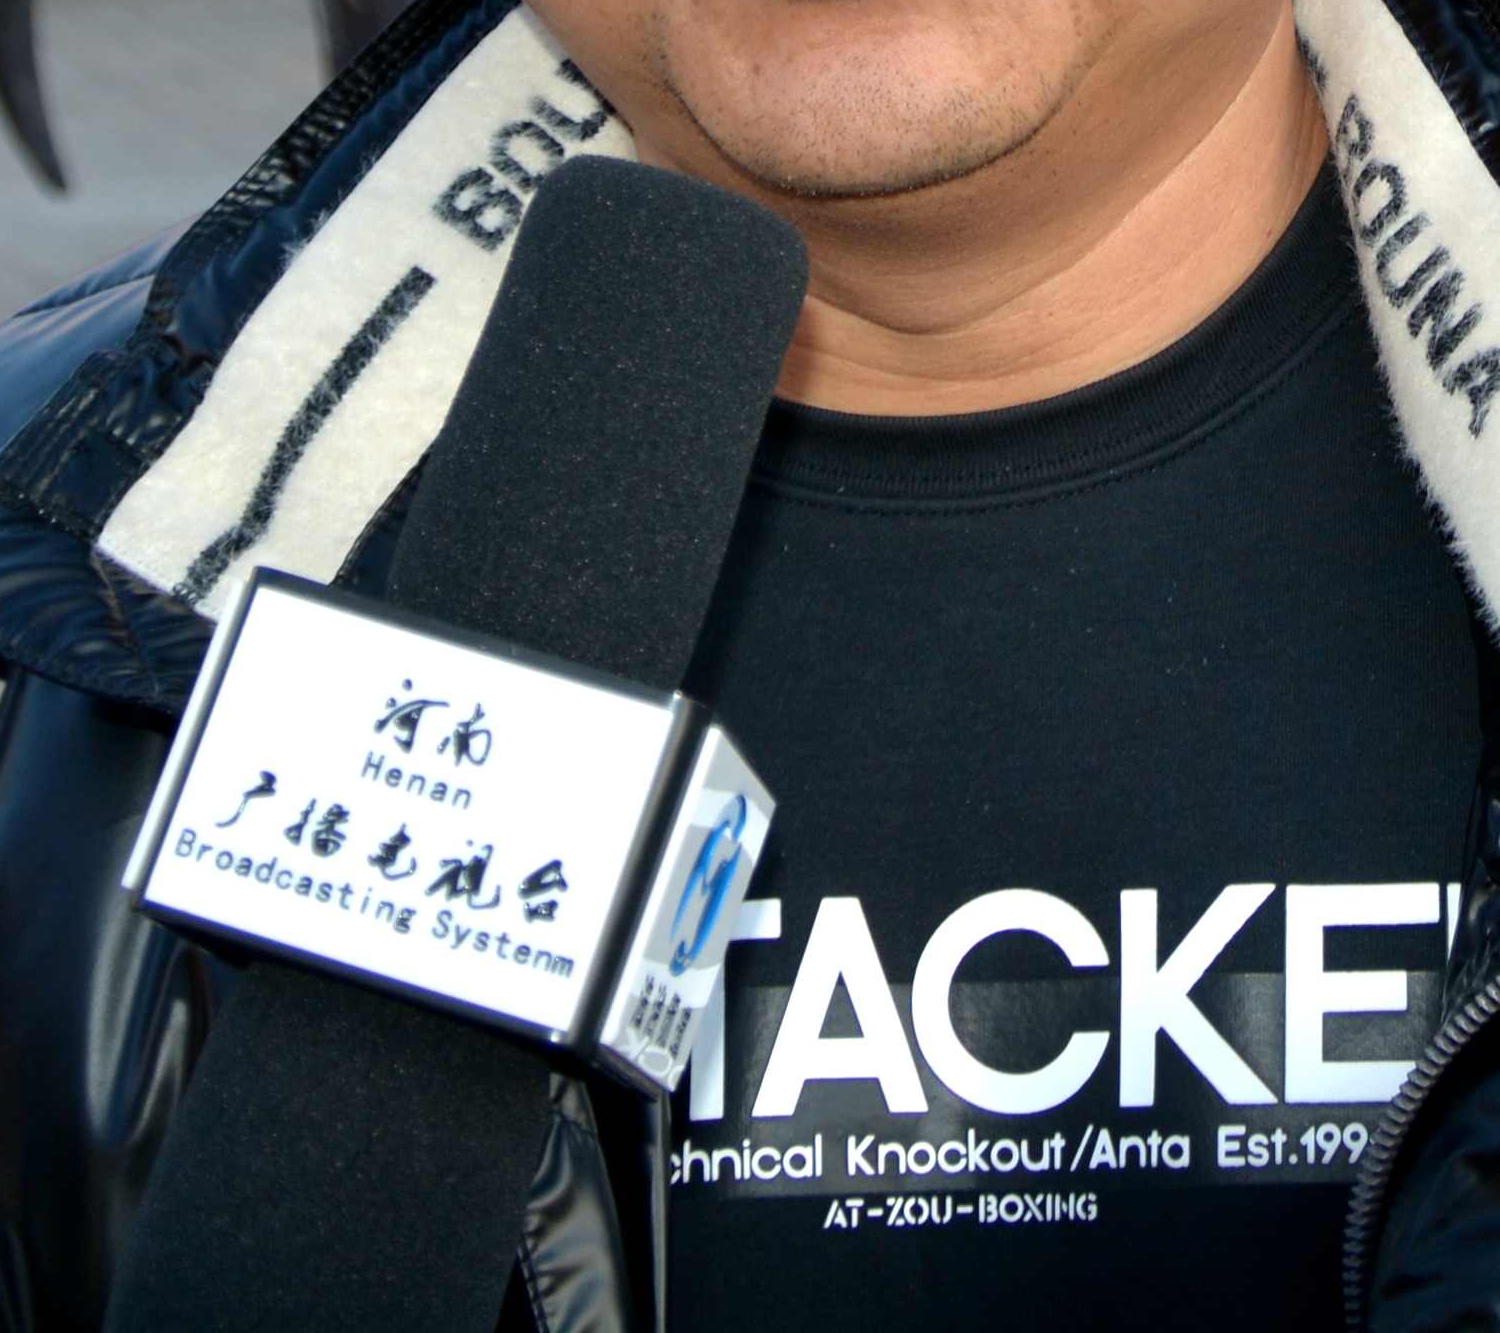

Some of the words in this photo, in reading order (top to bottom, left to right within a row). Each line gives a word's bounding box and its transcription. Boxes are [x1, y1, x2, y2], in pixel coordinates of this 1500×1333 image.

[372, 677, 494, 768] 河南
[359, 750, 474, 811] Henan
[172, 827, 418, 934] Broadcasting
[214, 770, 569, 924] 广播电视台
[689, 881, 1463, 1121] TACKE
[846, 1124, 1190, 1176] Knockout/Anta
[1216, 1121, 1376, 1169] Est.199
